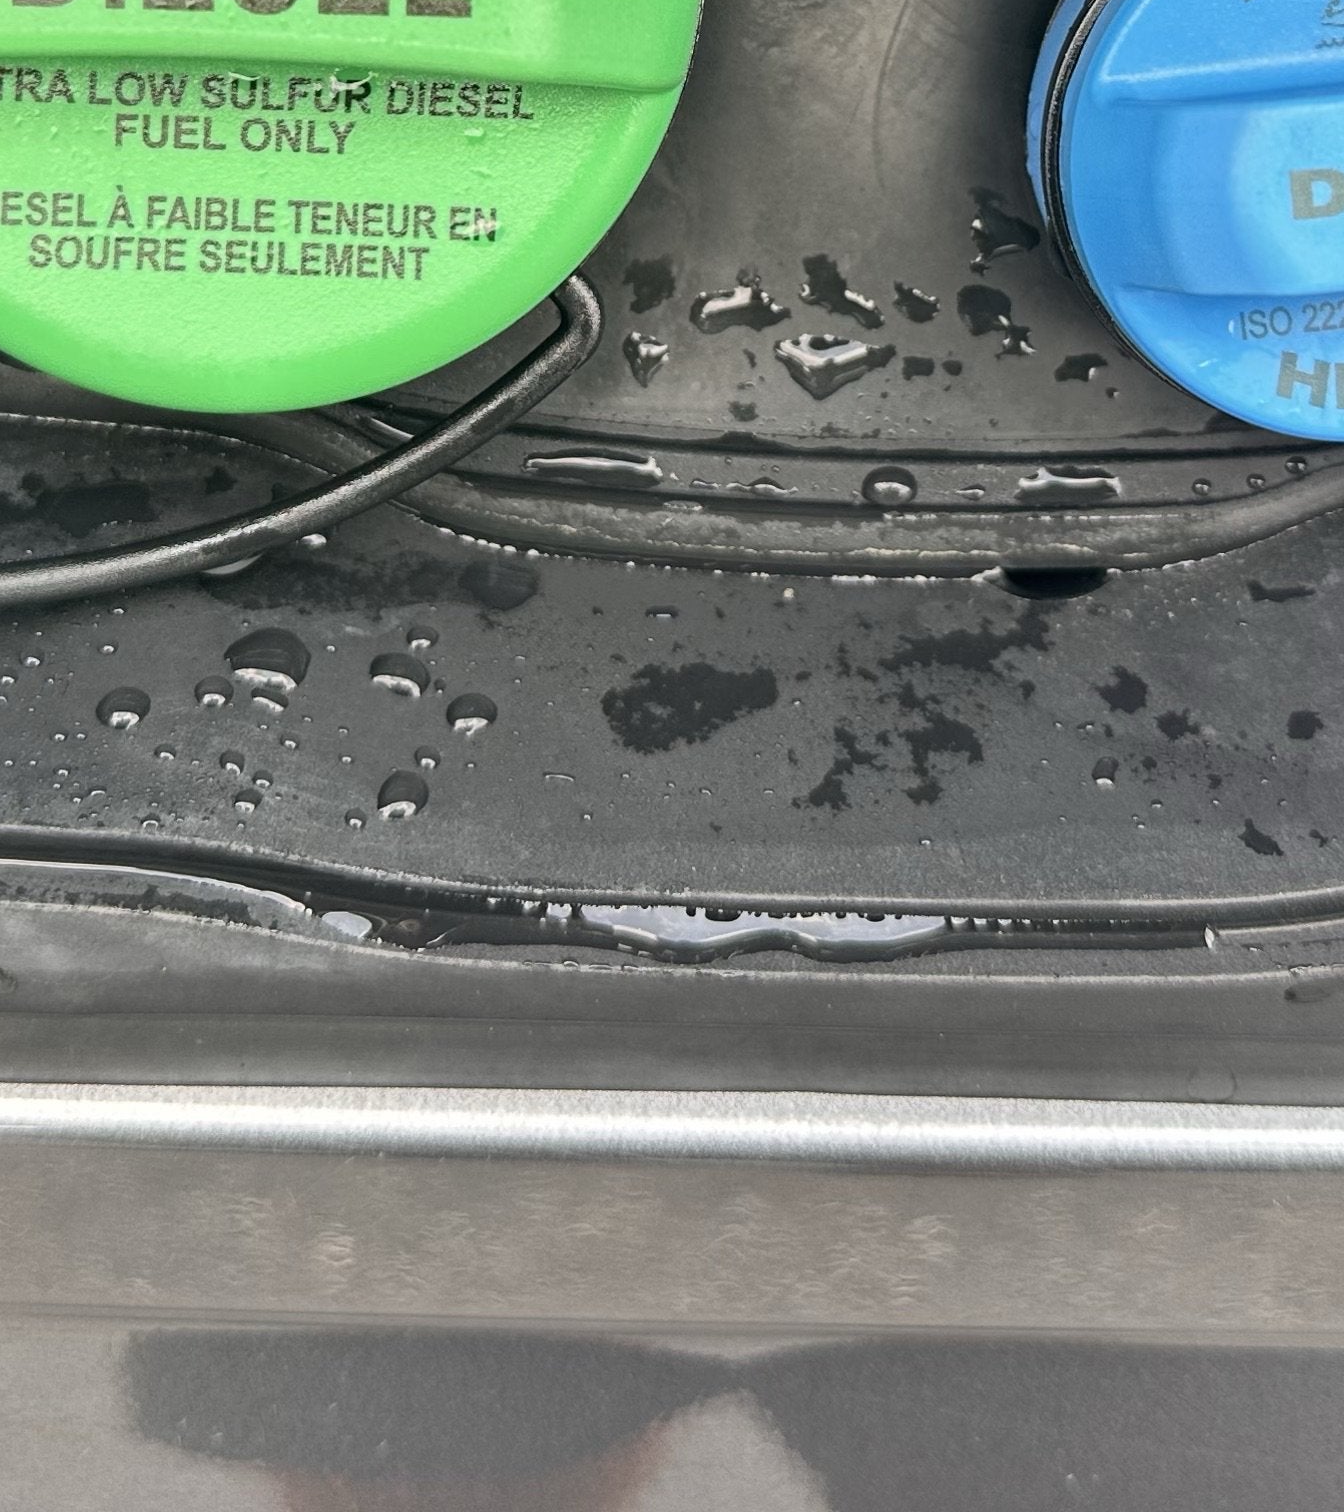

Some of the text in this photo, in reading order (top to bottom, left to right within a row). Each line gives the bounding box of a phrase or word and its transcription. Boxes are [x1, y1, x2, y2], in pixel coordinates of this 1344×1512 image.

[88, 70, 189, 107] LOW
[201, 73, 372, 114] SULFUR
[386, 80, 534, 119] DIESEL
[115, 113, 356, 155] FUEL ONLY
[106, 185, 135, 228] À
[146, 196, 276, 234] FAIBLE
[288, 200, 437, 239] TENEUR
[449, 206, 498, 242] EN
[28, 234, 430, 281] SOUFRE SEULEMENT
[1239, 306, 1293, 340] ISO
